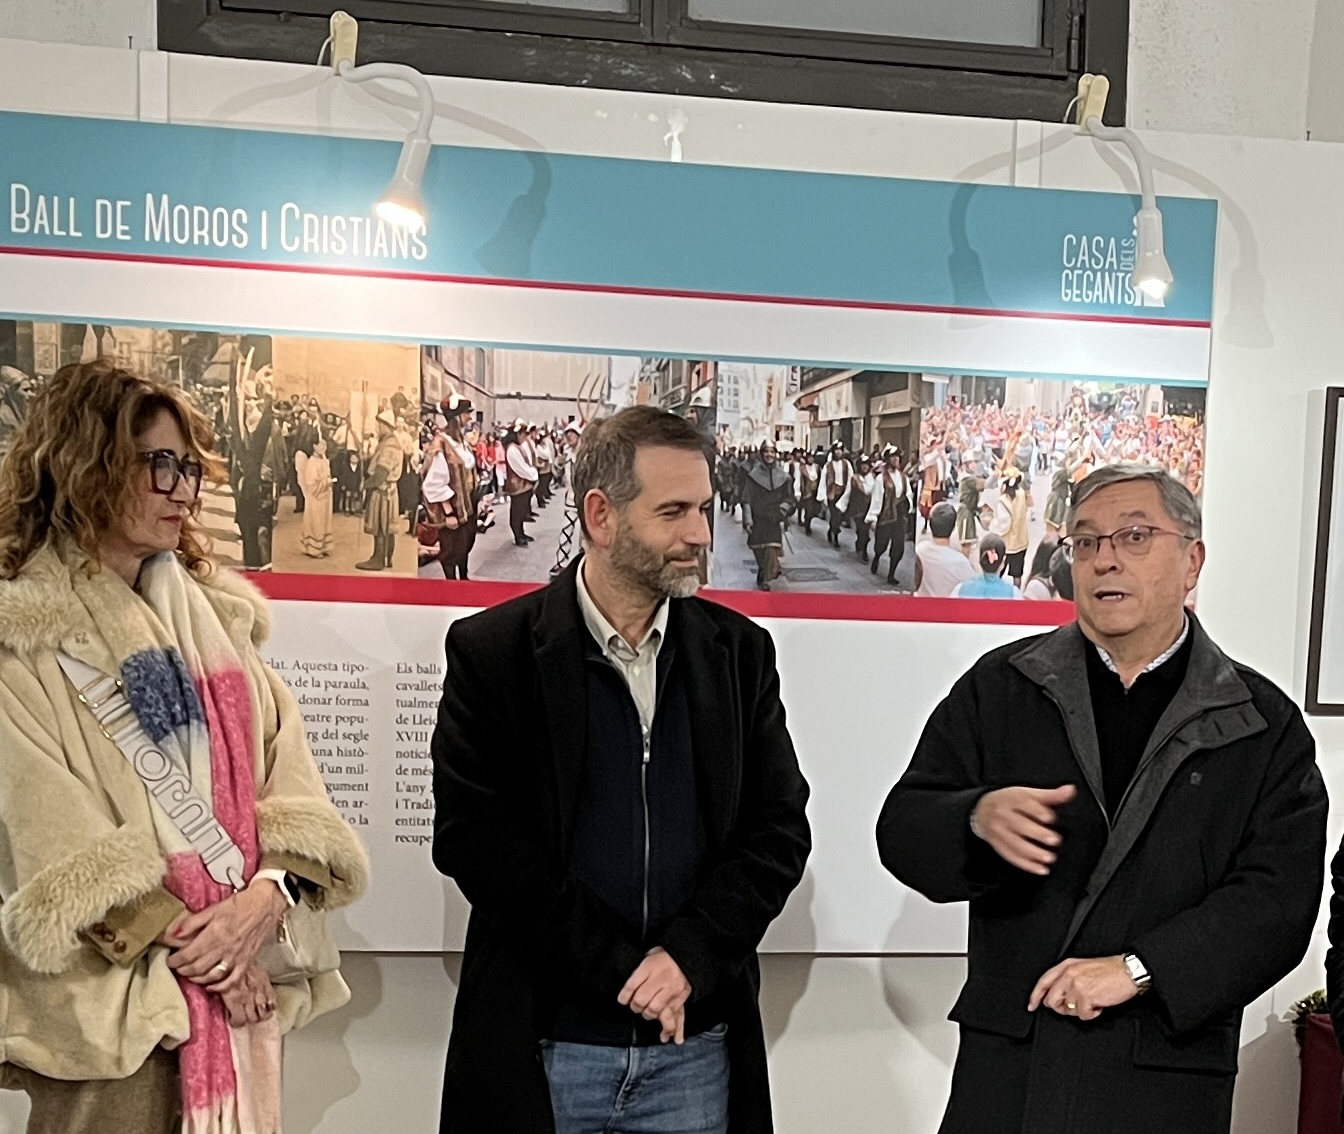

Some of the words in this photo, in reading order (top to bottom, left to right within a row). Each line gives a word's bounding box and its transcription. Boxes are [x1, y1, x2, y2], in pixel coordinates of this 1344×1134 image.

[94, 198, 132, 241] DE
[1062, 234, 1118, 270] CASA
[1120, 238, 1135, 271] DELS
[1061, 270, 1135, 305] GEGANTS
[266, 658, 288, 670] lat.
[292, 660, 338, 674] Aquesta
[342, 662, 369, 675] tipo-
[396, 662, 412, 674] Els
[416, 662, 442, 674] balls
[294, 676, 308, 688] de
[312, 676, 321, 688] la
[324, 678, 370, 692] paraula,
[396, 680, 443, 692] cavallets
[298, 694, 332, 706] donar
[336, 694, 370, 706] forma
[302, 713, 332, 723] eatre
[335, 714, 369, 726] popu-
[396, 713, 409, 724] de
[322, 728, 338, 740] del
[342, 729, 370, 744] segle
[396, 730, 428, 742] XVIII
[346, 763, 369, 774] mil-
[396, 764, 409, 776] de
[412, 765, 434, 776] més
[396, 781, 426, 796] L'any
[352, 800, 369, 808] ar-
[396, 798, 399, 810] i
[348, 816, 356, 824] o
[358, 814, 369, 825] la
